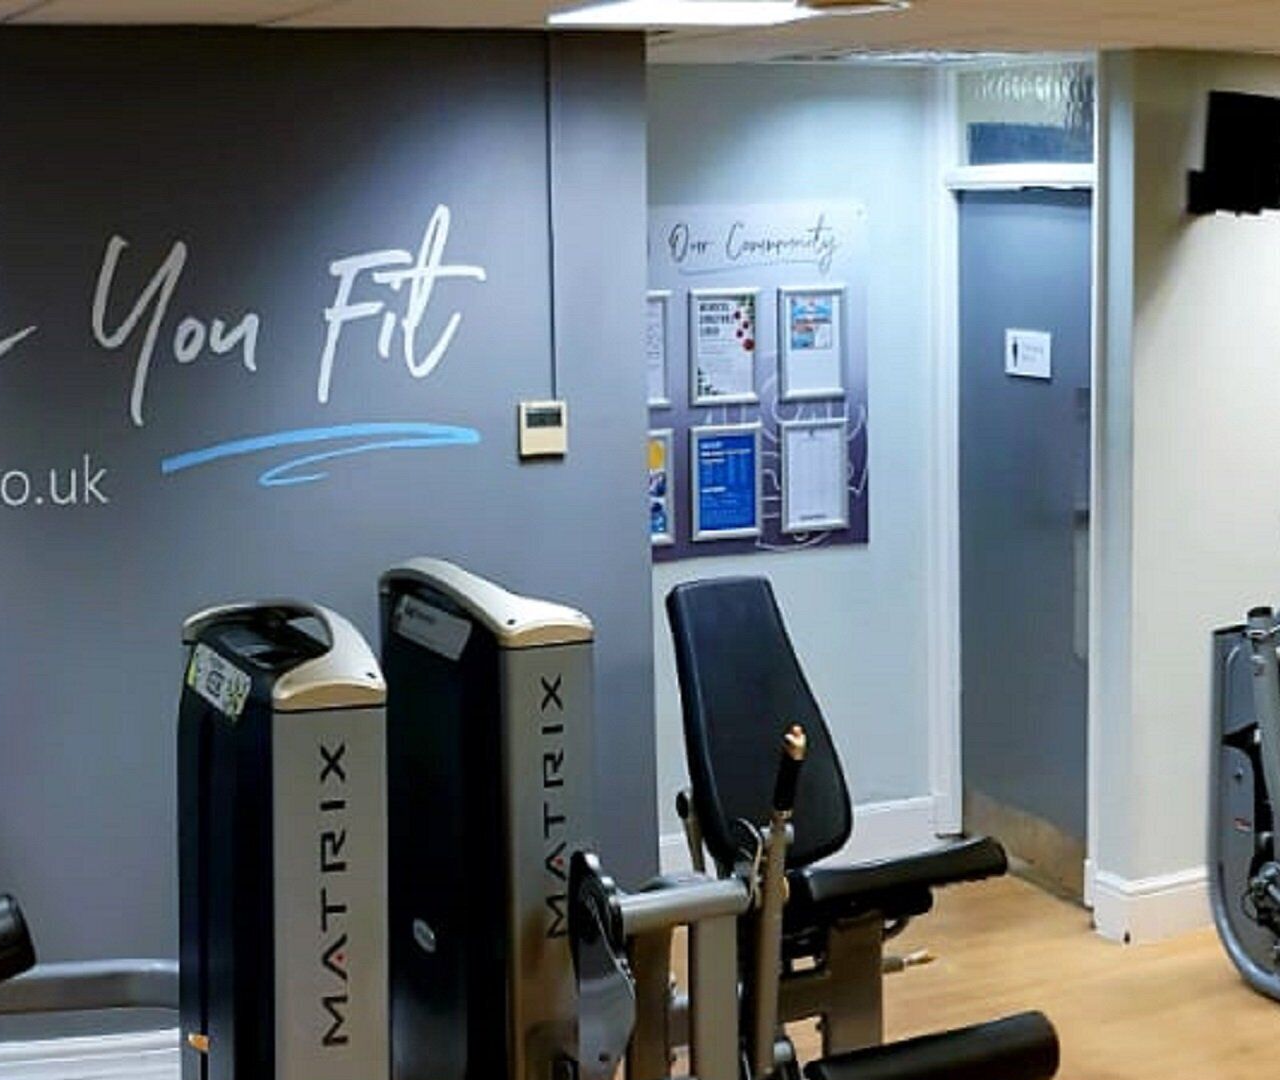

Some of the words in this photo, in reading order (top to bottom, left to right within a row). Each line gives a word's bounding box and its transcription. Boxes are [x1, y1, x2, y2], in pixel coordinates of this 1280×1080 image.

[92, 235, 260, 427] You
[318, 203, 487, 404] Fit
[319, 742, 349, 1048] MATRIX
[539, 672, 570, 940] MATRIX
